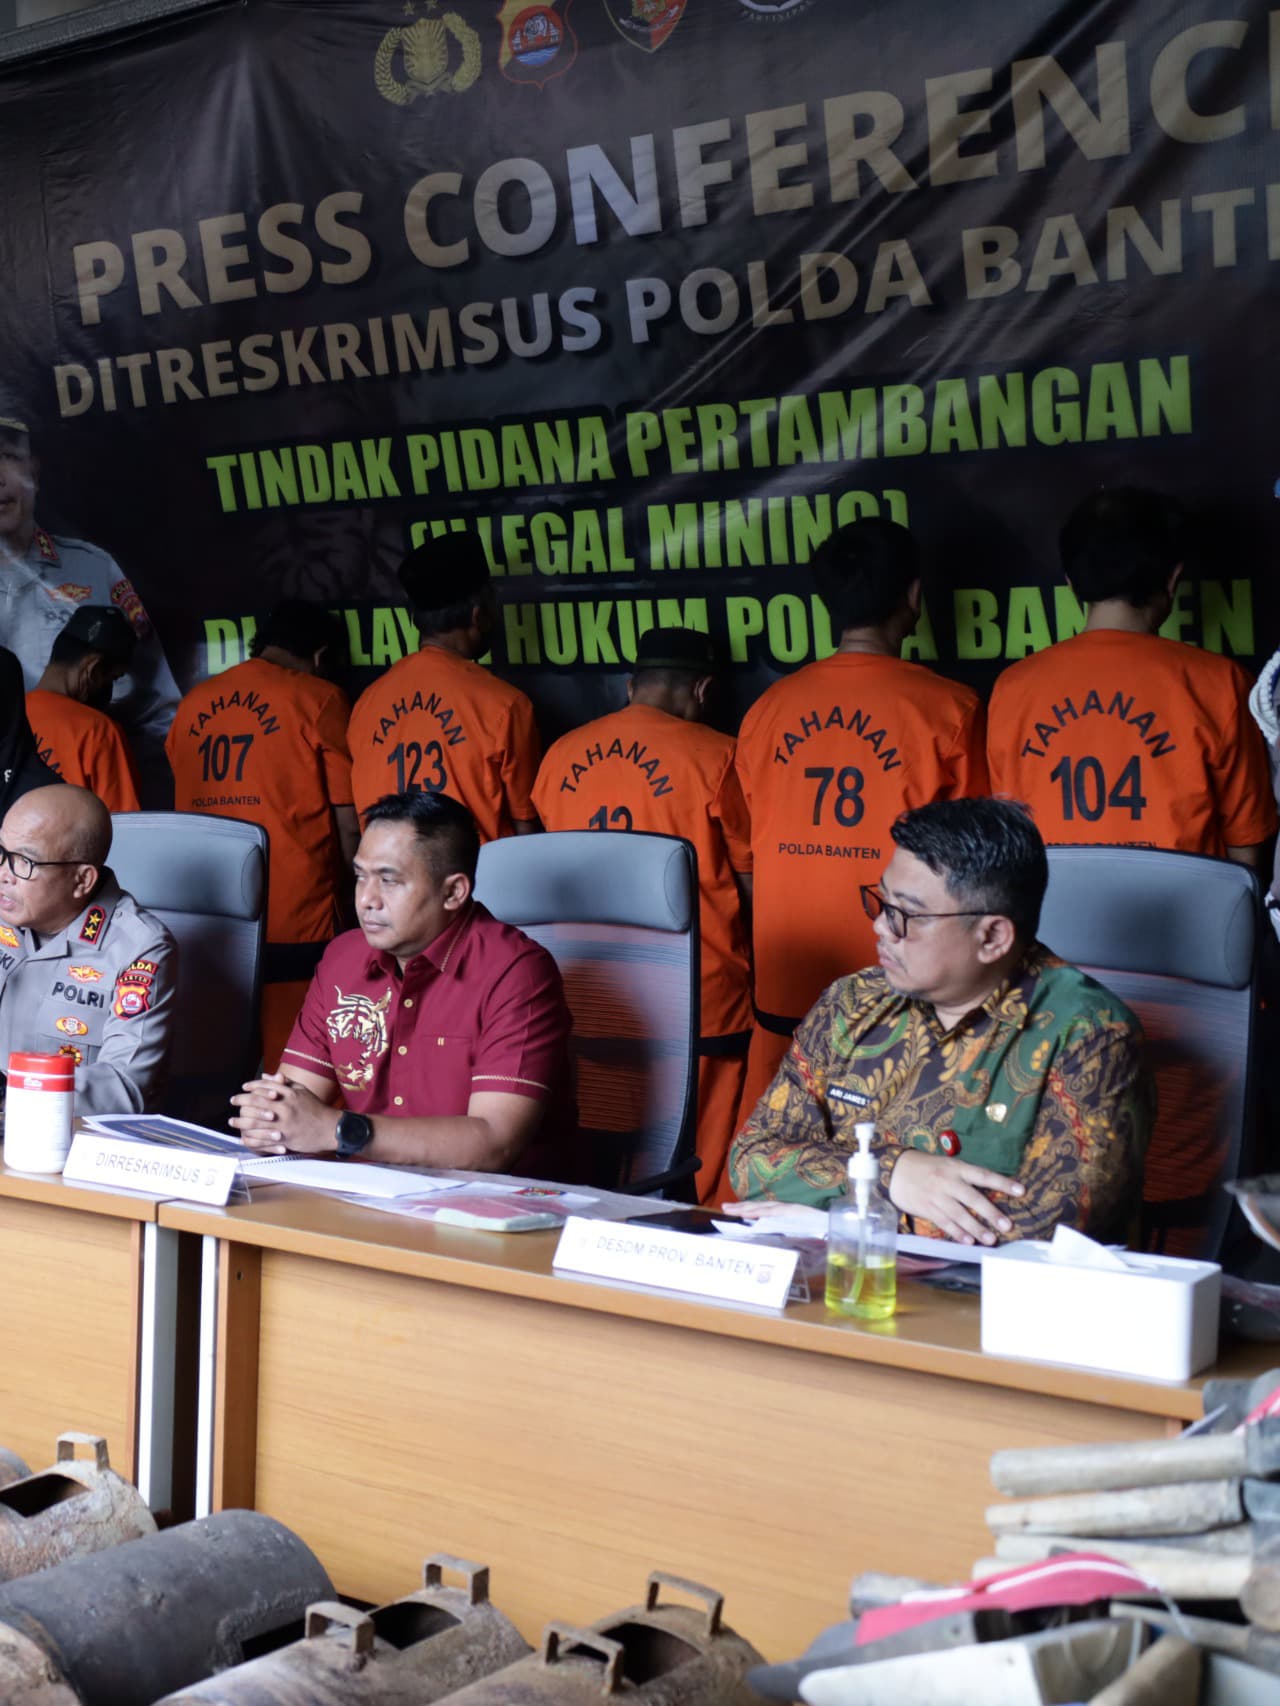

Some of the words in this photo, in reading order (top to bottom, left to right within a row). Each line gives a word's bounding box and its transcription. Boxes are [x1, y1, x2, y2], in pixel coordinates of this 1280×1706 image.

[73, 192, 372, 325] PRESS
[404, 8, 1280, 269] CONFERENC
[54, 286, 602, 417] DITRESKRIMSUS
[625, 239, 933, 344] POLDA
[962, 183, 1280, 299] BANT
[206, 437, 402, 512] TINDAK
[407, 416, 616, 495] PIDANA
[626, 355, 1193, 478] PERTAMBANGAN
[726, 594, 940, 664] POLA
[952, 578, 1256, 661] BANEN
[189, 690, 280, 738] TAHANAN
[372, 690, 467, 748] TAHANAN
[773, 705, 902, 774] TAHANAN
[1021, 689, 1177, 763] TAHANAN
[198, 733, 254, 783] 107
[387, 740, 449, 794] 123
[560, 738, 674, 799] TAHANAN
[1050, 754, 1147, 822] 104
[804, 766, 865, 829] 78
[778, 842, 824, 857] POLDA
[825, 845, 881, 860] BANTEN
[51, 981, 105, 1009] POLRI
[95, 1151, 201, 1184] DIRRESKRIMSUS
[694, 1252, 756, 1276] BANTEN
